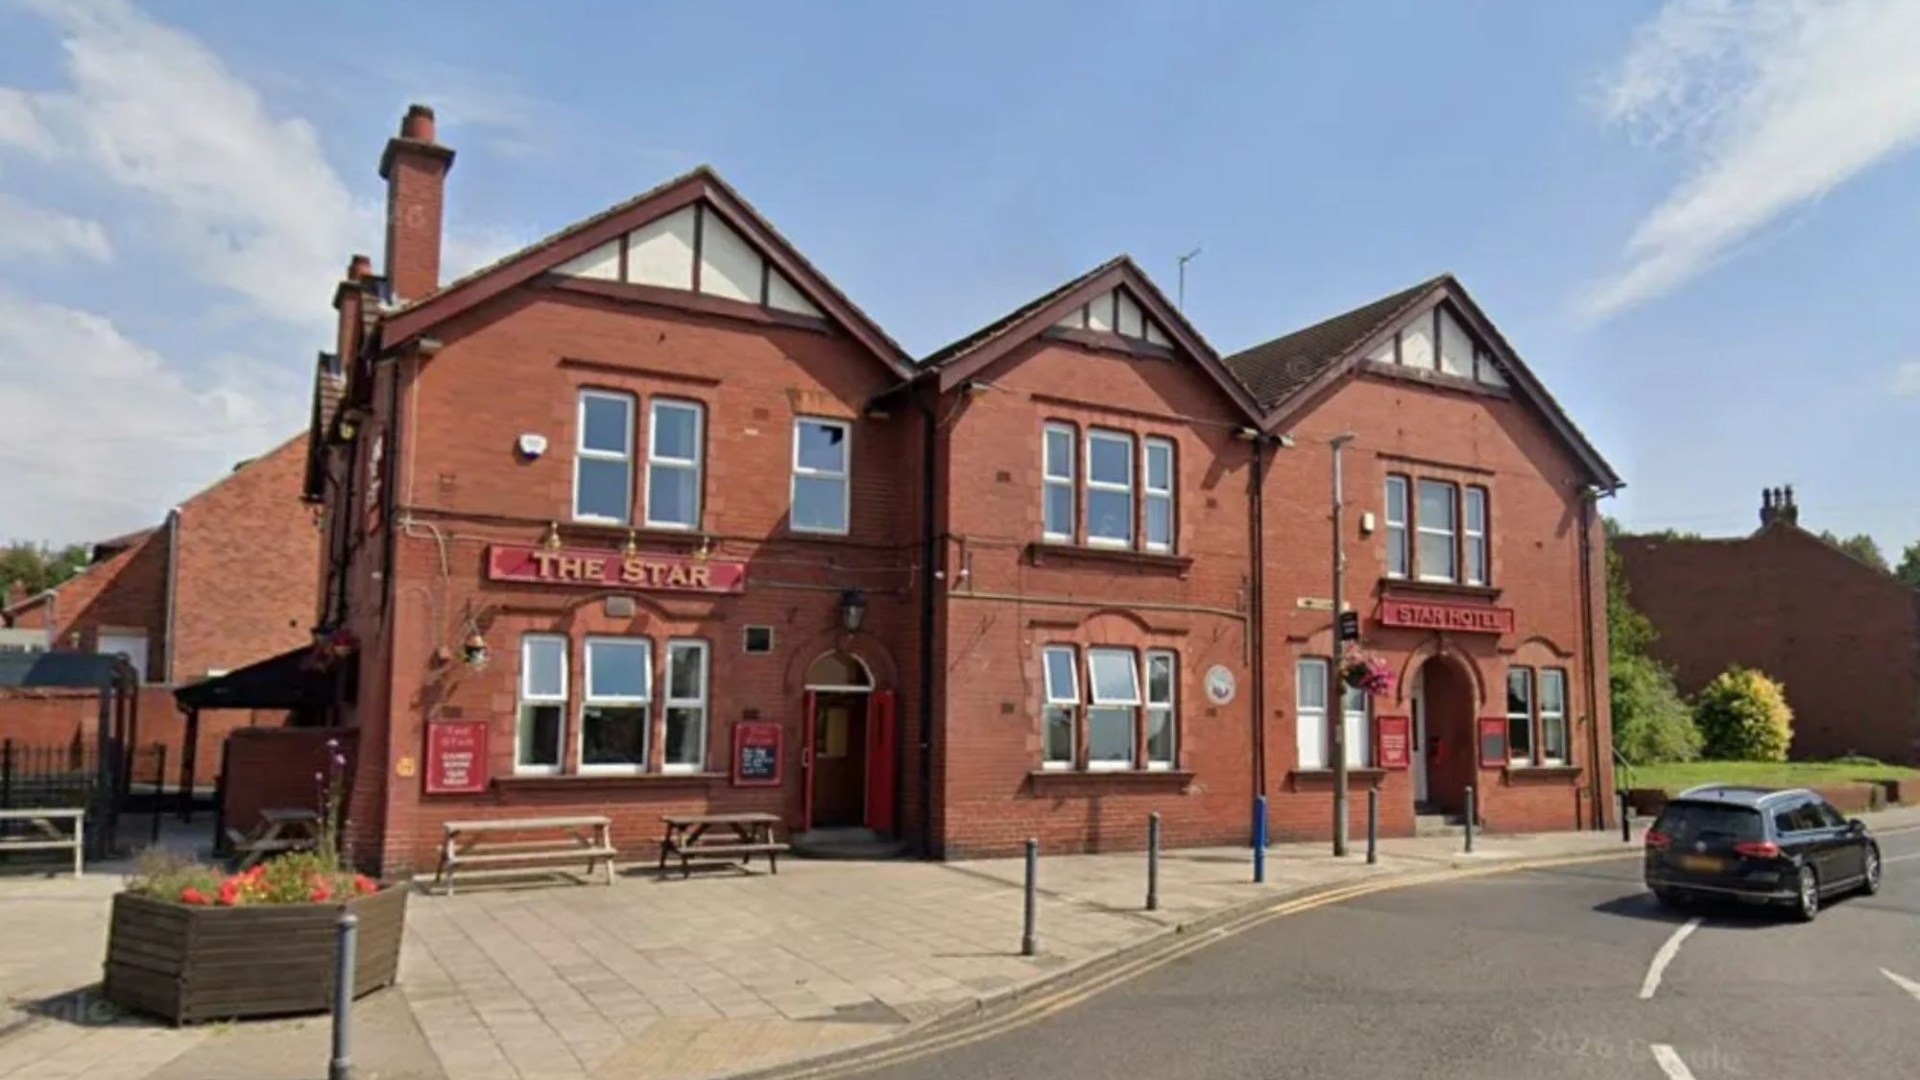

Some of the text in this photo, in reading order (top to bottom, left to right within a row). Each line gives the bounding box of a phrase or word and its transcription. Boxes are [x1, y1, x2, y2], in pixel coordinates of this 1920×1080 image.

[533, 551, 710, 586] THE STAR
[1398, 604, 1499, 627] STAR HOTEL
